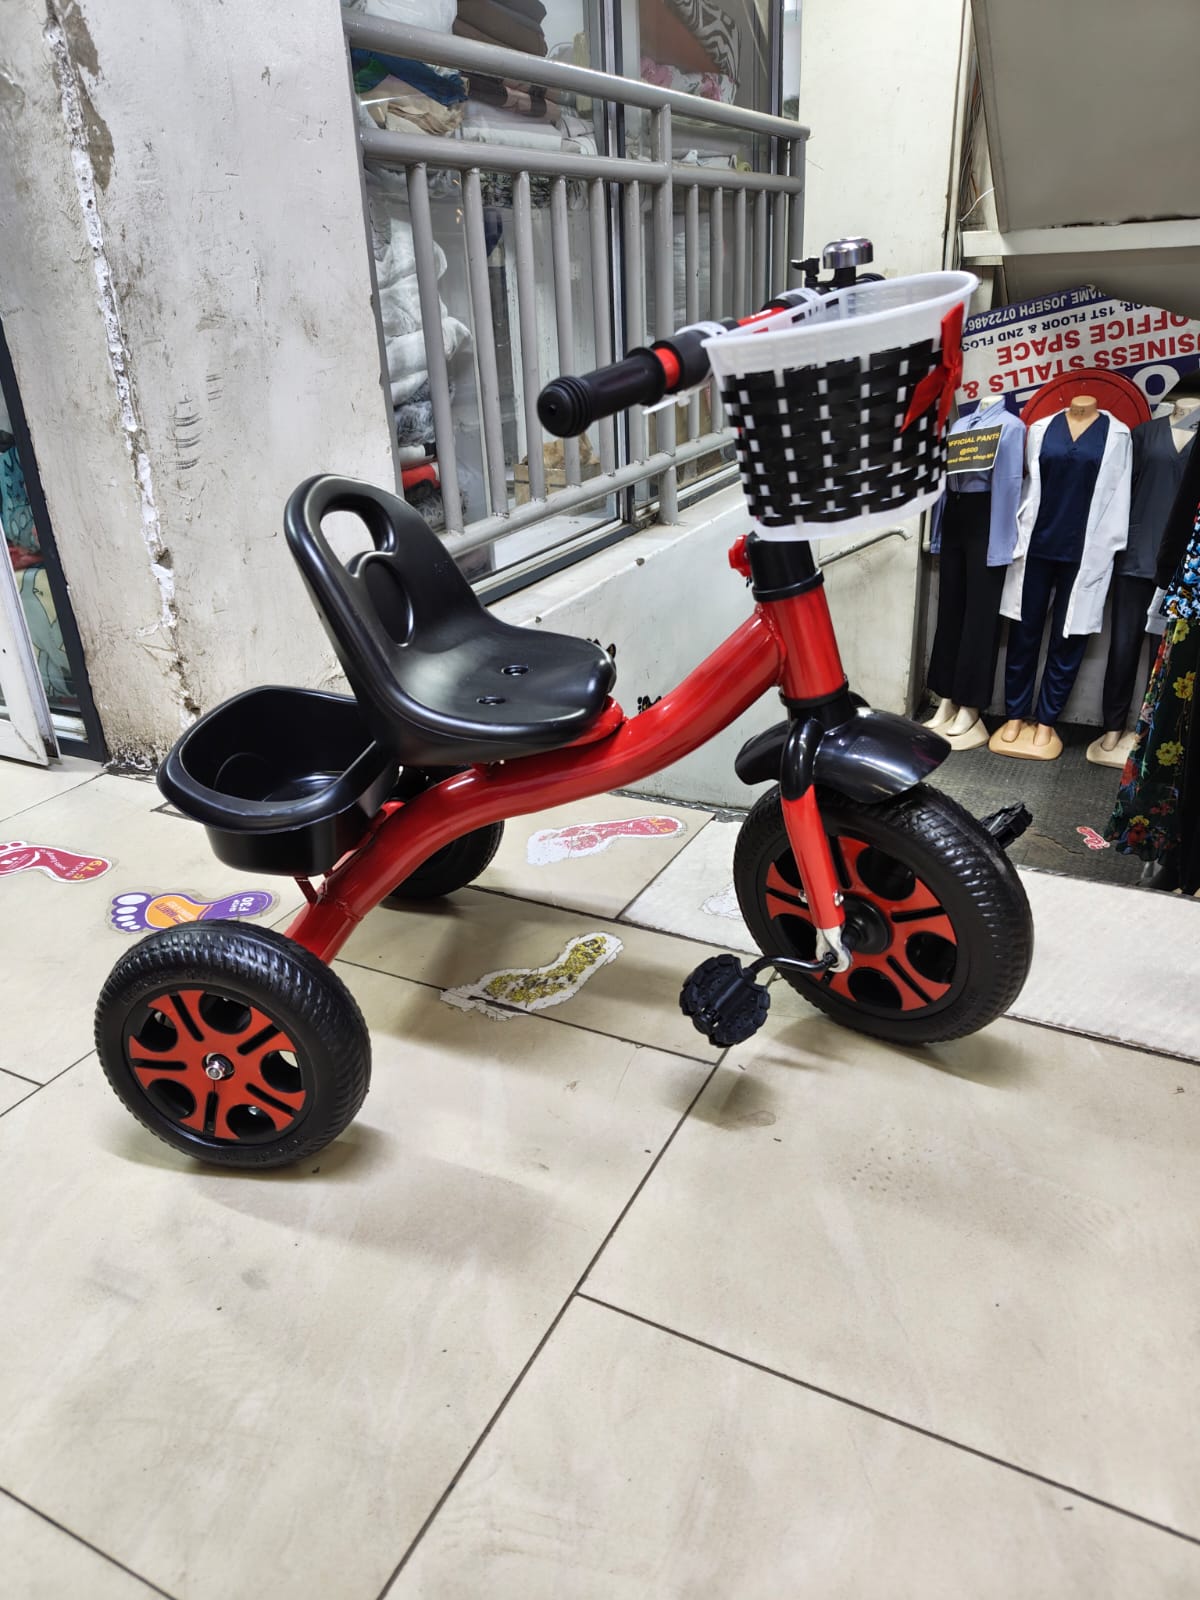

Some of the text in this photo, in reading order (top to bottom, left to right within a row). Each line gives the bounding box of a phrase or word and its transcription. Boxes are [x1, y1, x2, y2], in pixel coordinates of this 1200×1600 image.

[1019, 295, 1067, 316] JOSEPH
[1090, 306, 1116, 320] 1ST
[965, 308, 1017, 332] 0722486
[1027, 324, 1038, 334] &
[1041, 311, 1087, 331] FLOOR
[996, 310, 1190, 366] OFFICE SPACE
[997, 328, 1024, 342] 2ND
[988, 355, 1085, 393] STALLS
[962, 380, 980, 399] &
[238, 896, 255, 912] F30
